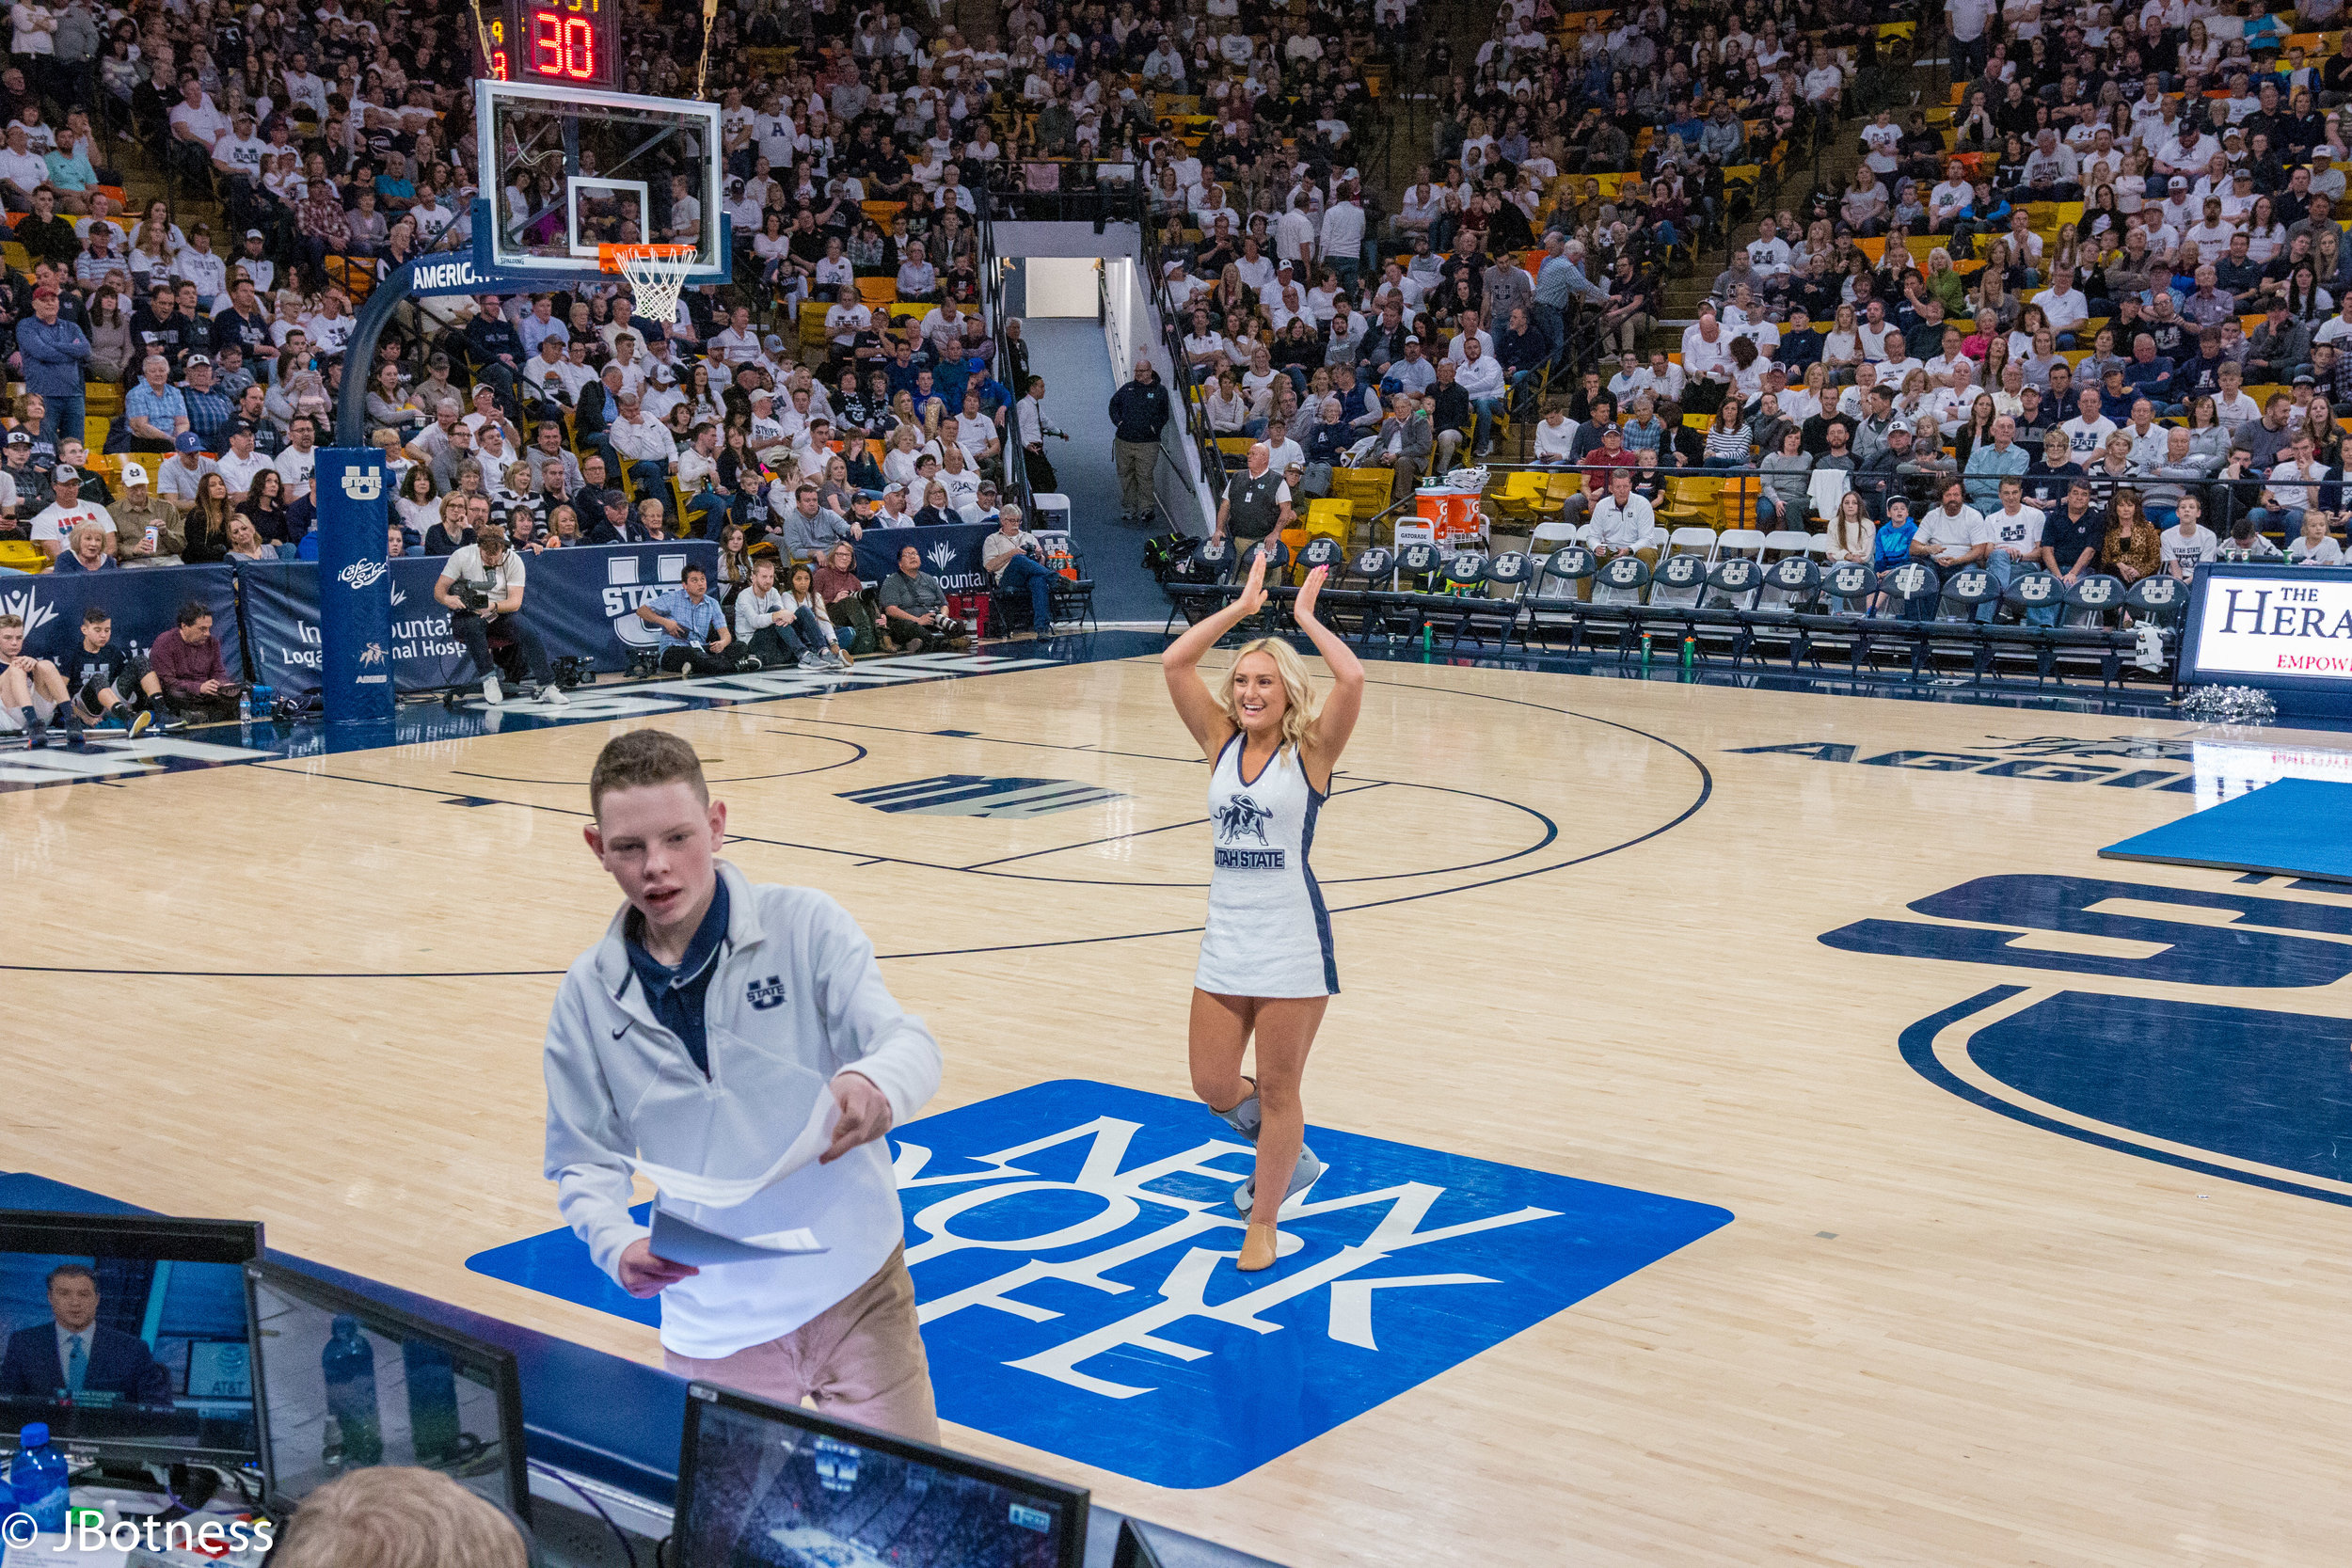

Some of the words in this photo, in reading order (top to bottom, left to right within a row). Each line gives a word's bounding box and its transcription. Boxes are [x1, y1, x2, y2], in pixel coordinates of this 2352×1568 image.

[491, 21, 504, 44] 9
[536, 12, 594, 79] 30
[341, 476, 382, 489] STATE
[1400, 532, 1427, 541] GATORADE
[2000, 529, 2026, 537] STATE
[602, 584, 686, 617] STA
[2280, 587, 2319, 602] THE
[282, 646, 323, 671] Loga
[430, 641, 468, 658] Hosp
[2277, 654, 2352, 672] EMPOW
[1240, 848, 1285, 869] STATE
[746, 983, 787, 1003] STATE
[211, 1379, 246, 1394] AT&T
